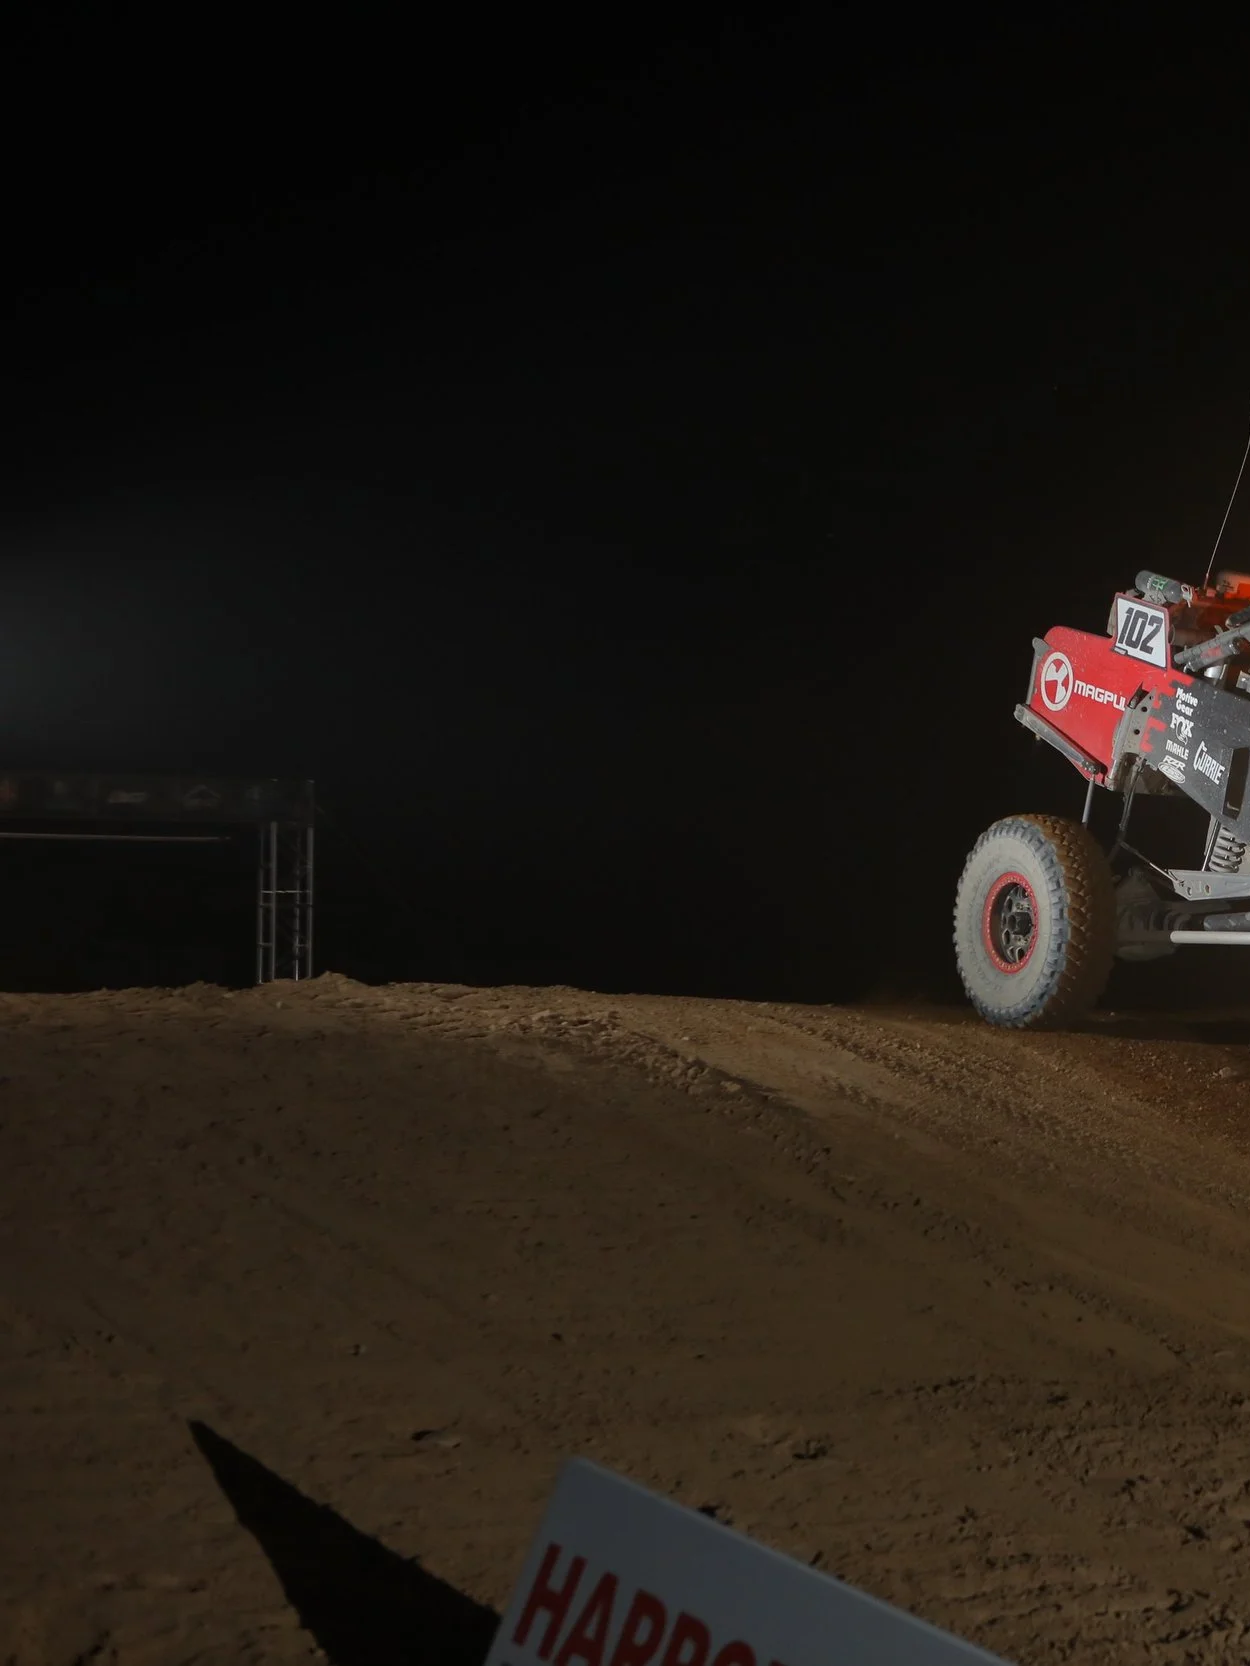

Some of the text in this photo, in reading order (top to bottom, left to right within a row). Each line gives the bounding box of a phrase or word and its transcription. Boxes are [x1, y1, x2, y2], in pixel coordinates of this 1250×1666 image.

[1118, 607, 1163, 654] 102
[1074, 680, 1128, 712] MAGPUL
[1176, 687, 1198, 707] Motive
[1176, 699, 1194, 716] Gear
[1170, 712, 1194, 737] FOX
[1193, 740, 1226, 785] CURRIE
